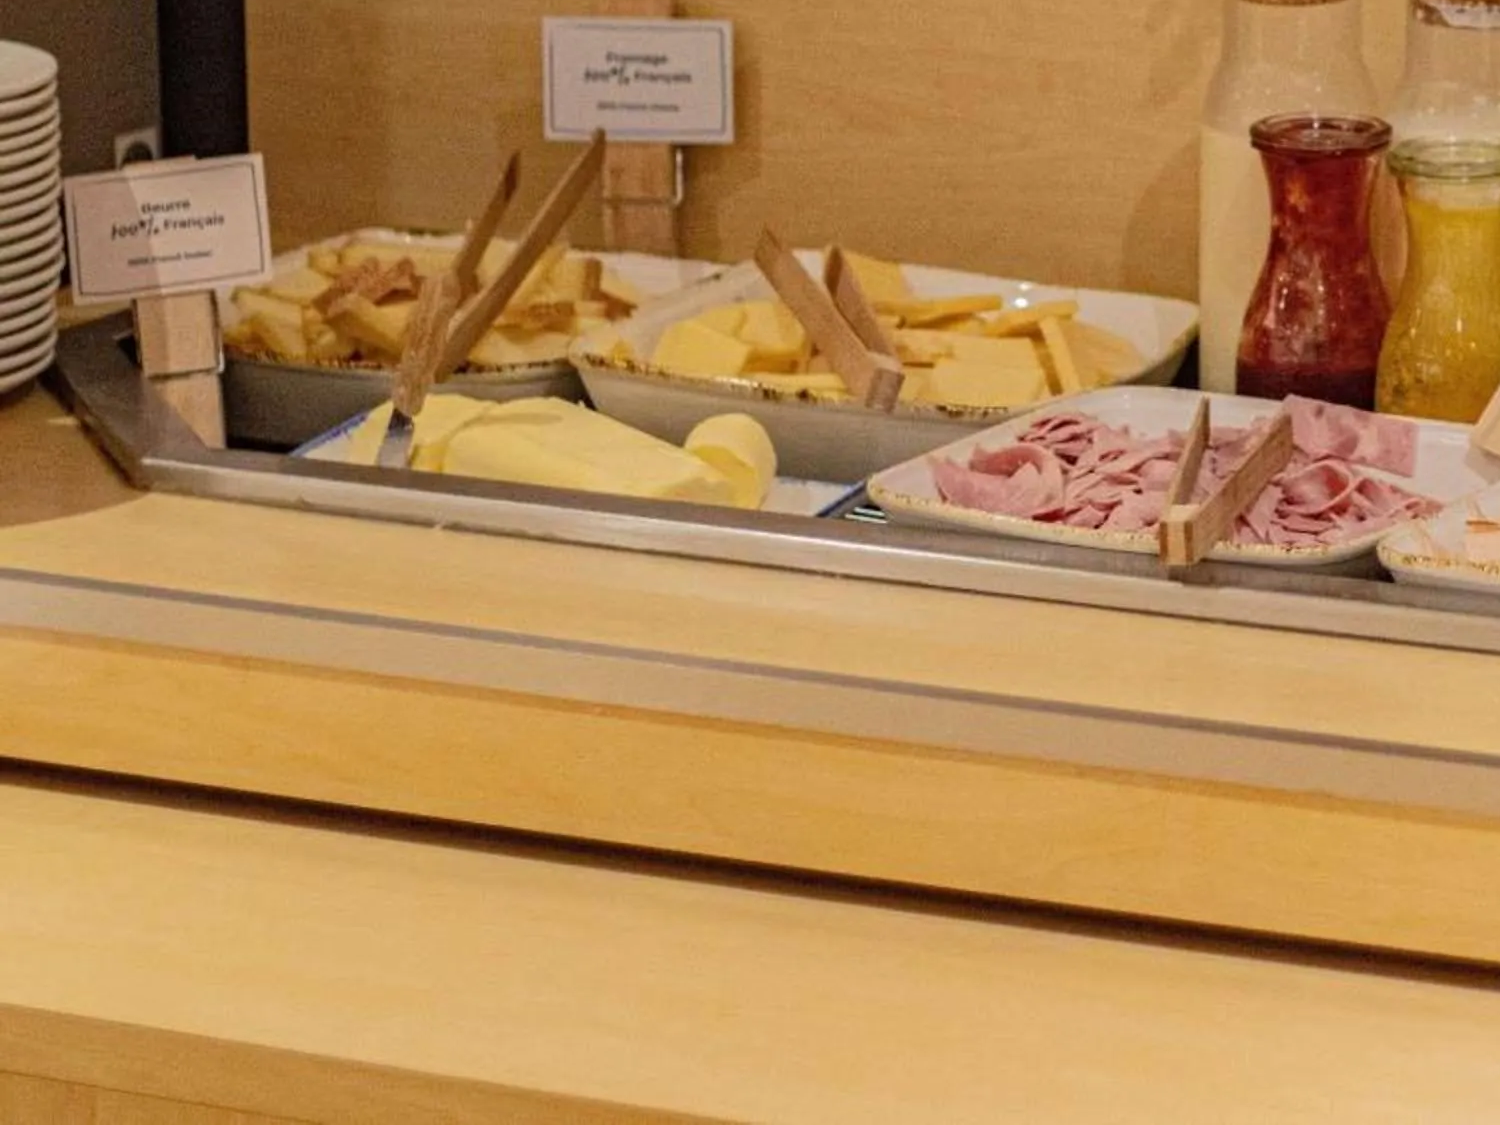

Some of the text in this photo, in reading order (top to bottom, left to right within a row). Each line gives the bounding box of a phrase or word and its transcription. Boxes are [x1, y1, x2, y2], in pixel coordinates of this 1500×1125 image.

[633, 70, 693, 85] Français
[141, 198, 191, 215] Beurre
[111, 210, 225, 241] 100% Français
